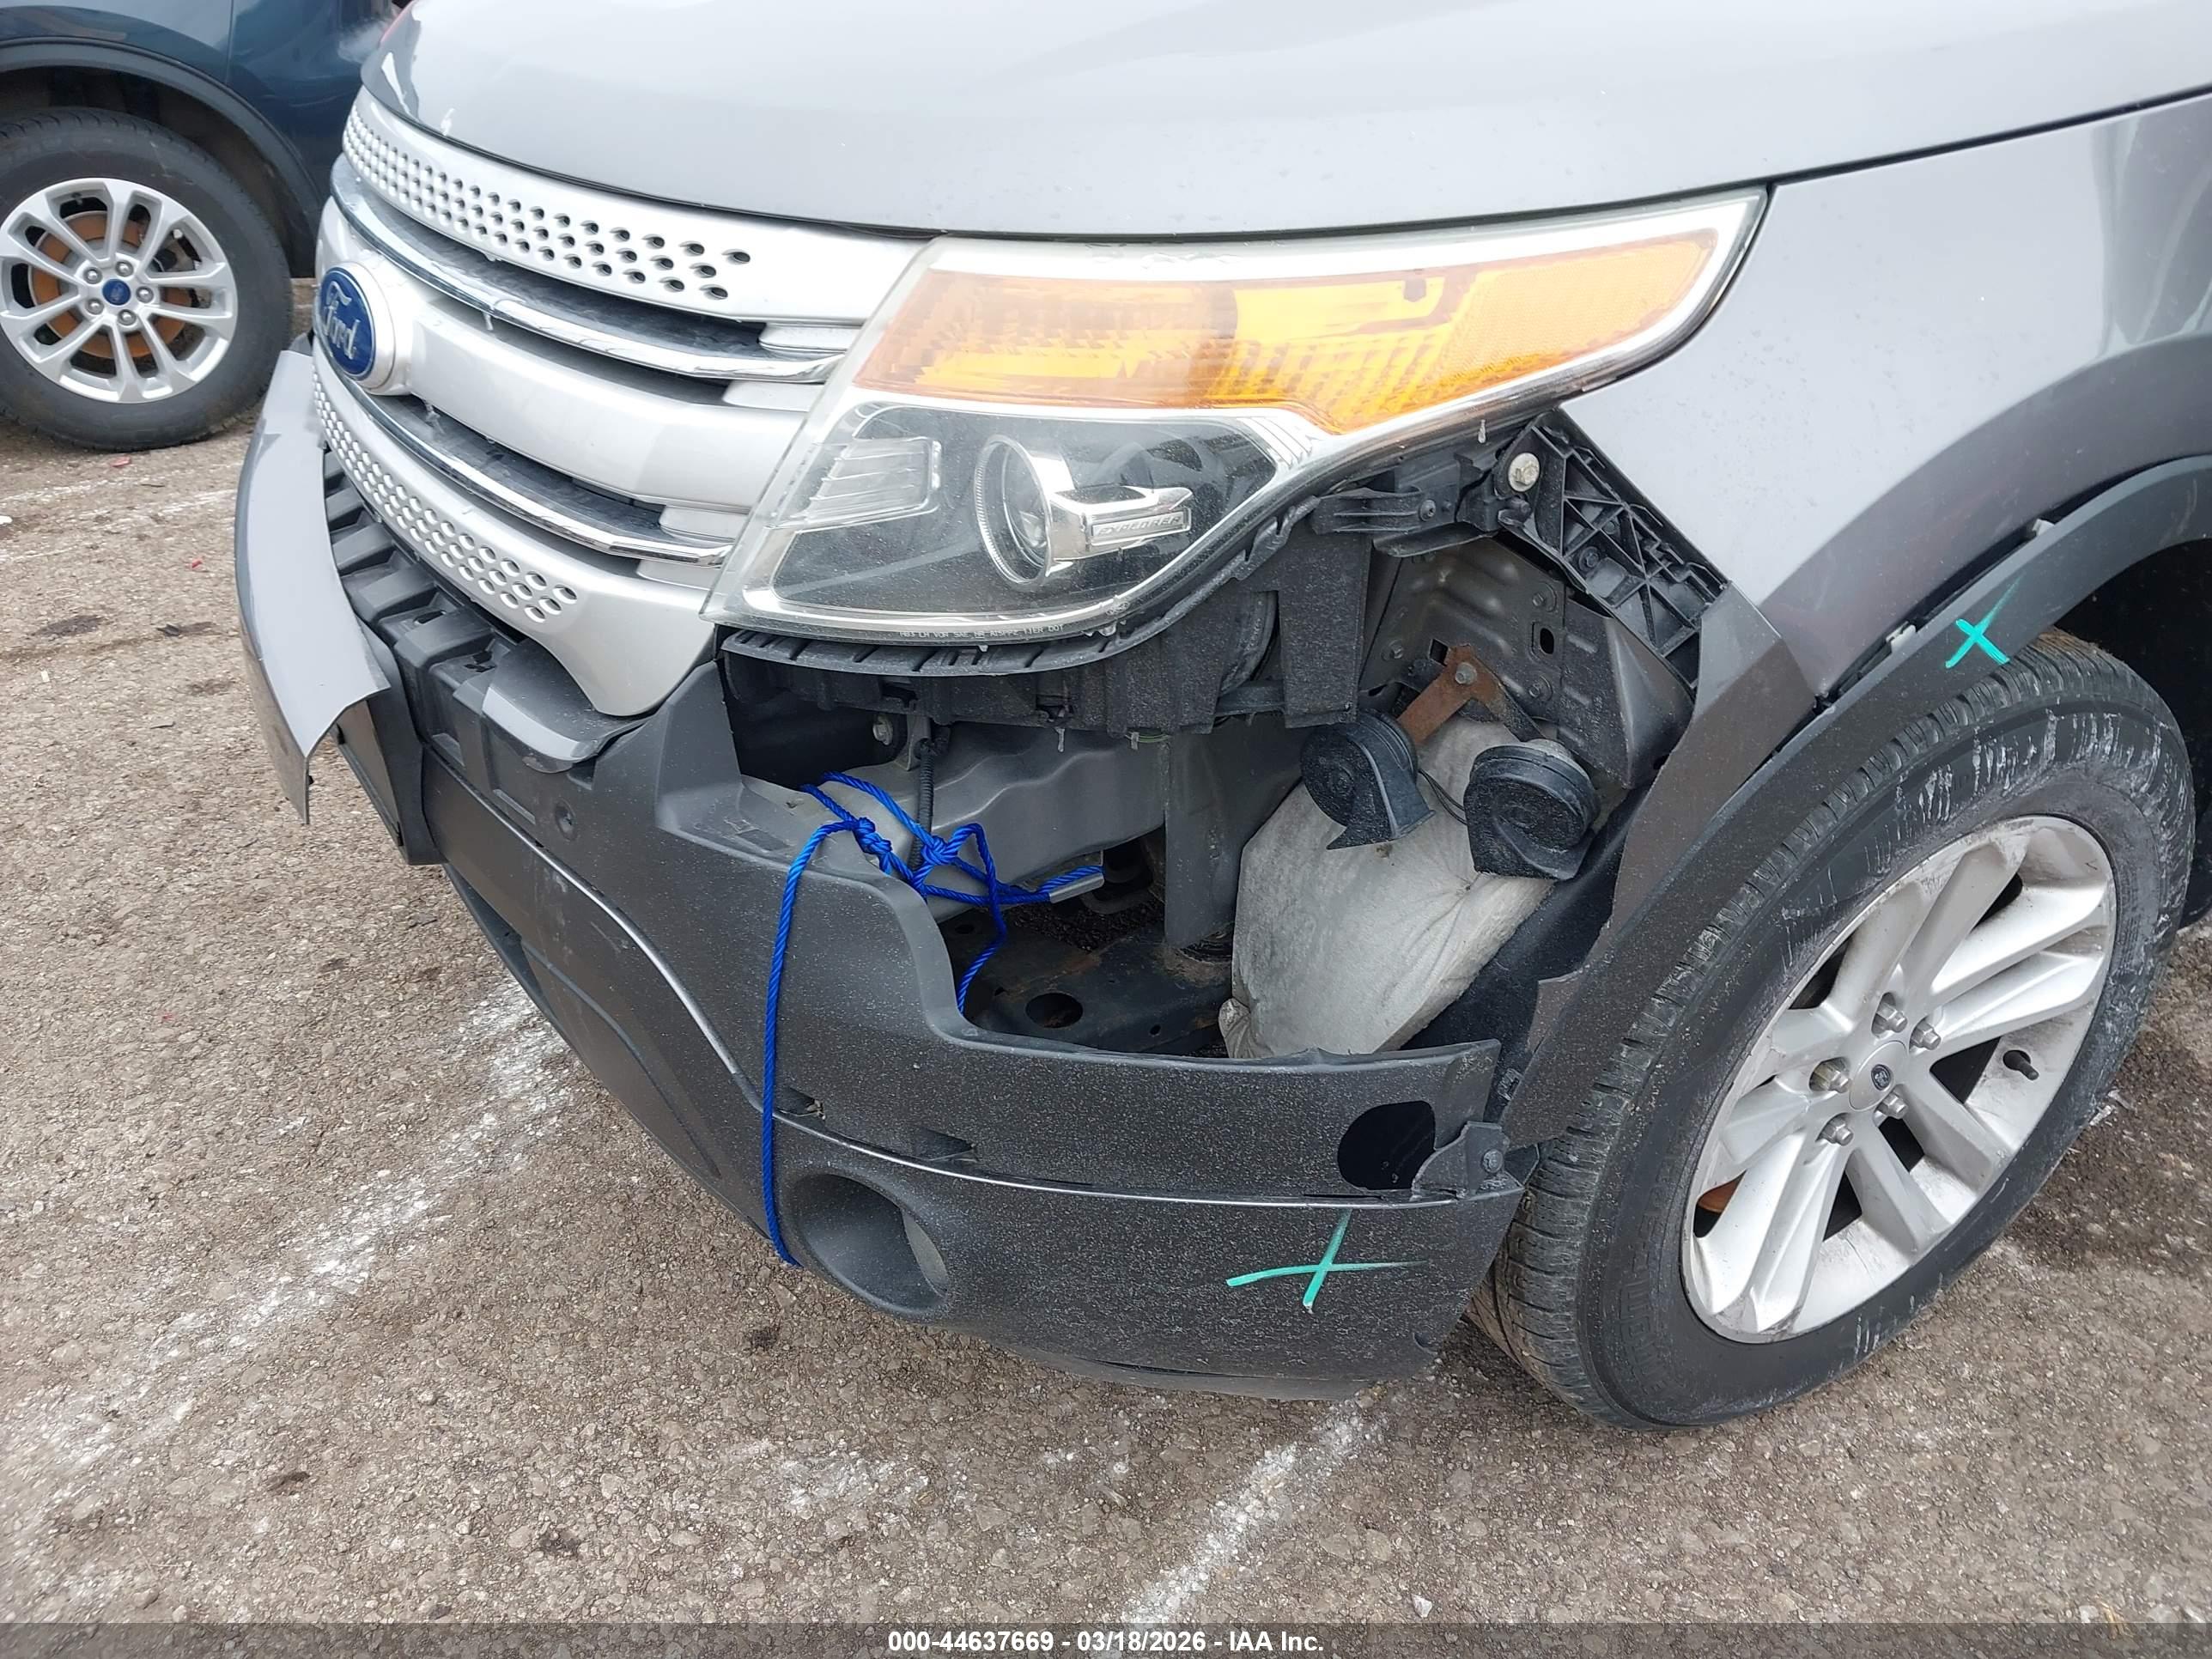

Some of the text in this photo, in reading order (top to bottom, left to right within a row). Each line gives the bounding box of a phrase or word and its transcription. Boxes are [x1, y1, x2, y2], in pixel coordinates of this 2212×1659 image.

[323, 280, 361, 360] Ford
[1098, 515, 1182, 536] EXPLORER
[1048, 623, 1064, 632] DOT
